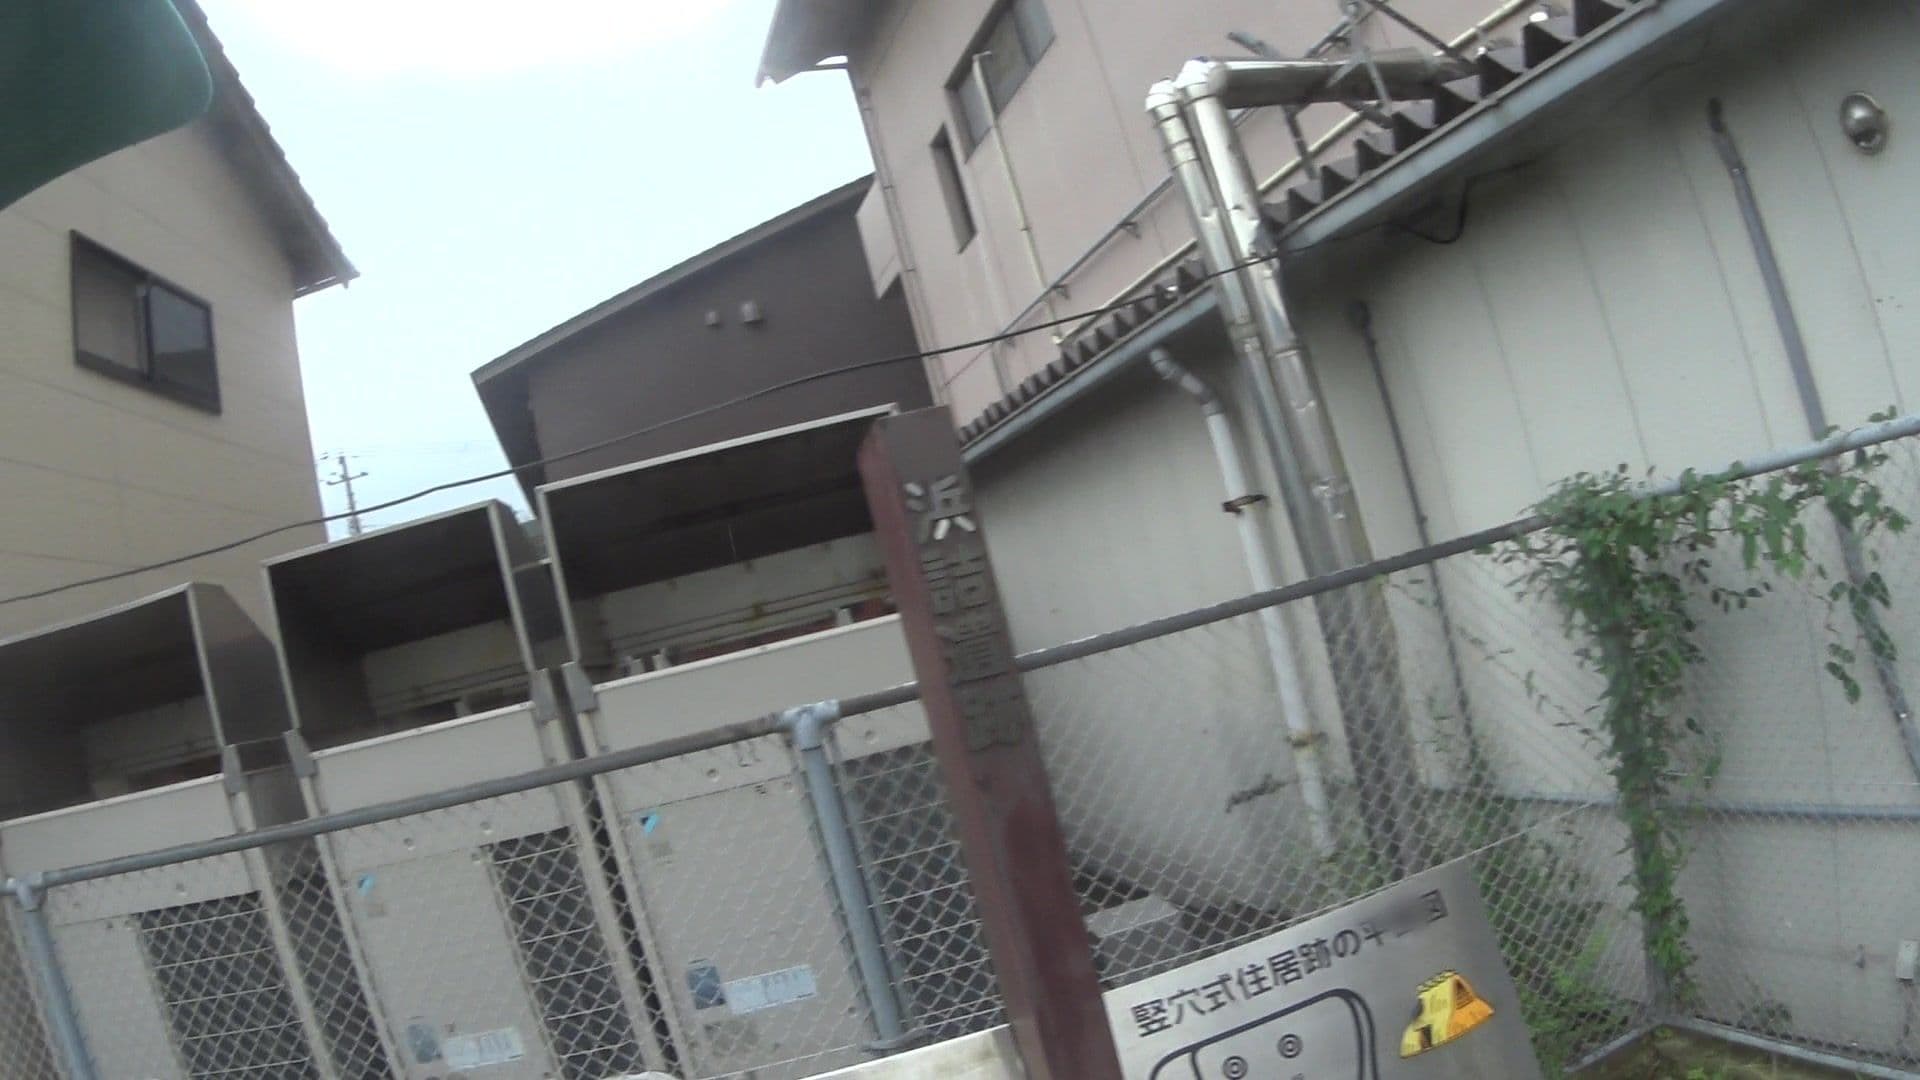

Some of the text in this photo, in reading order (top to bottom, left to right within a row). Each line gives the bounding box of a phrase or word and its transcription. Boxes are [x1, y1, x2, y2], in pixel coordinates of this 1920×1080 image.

[1131, 889, 1448, 1037] 竪穴式住居跡の平図
